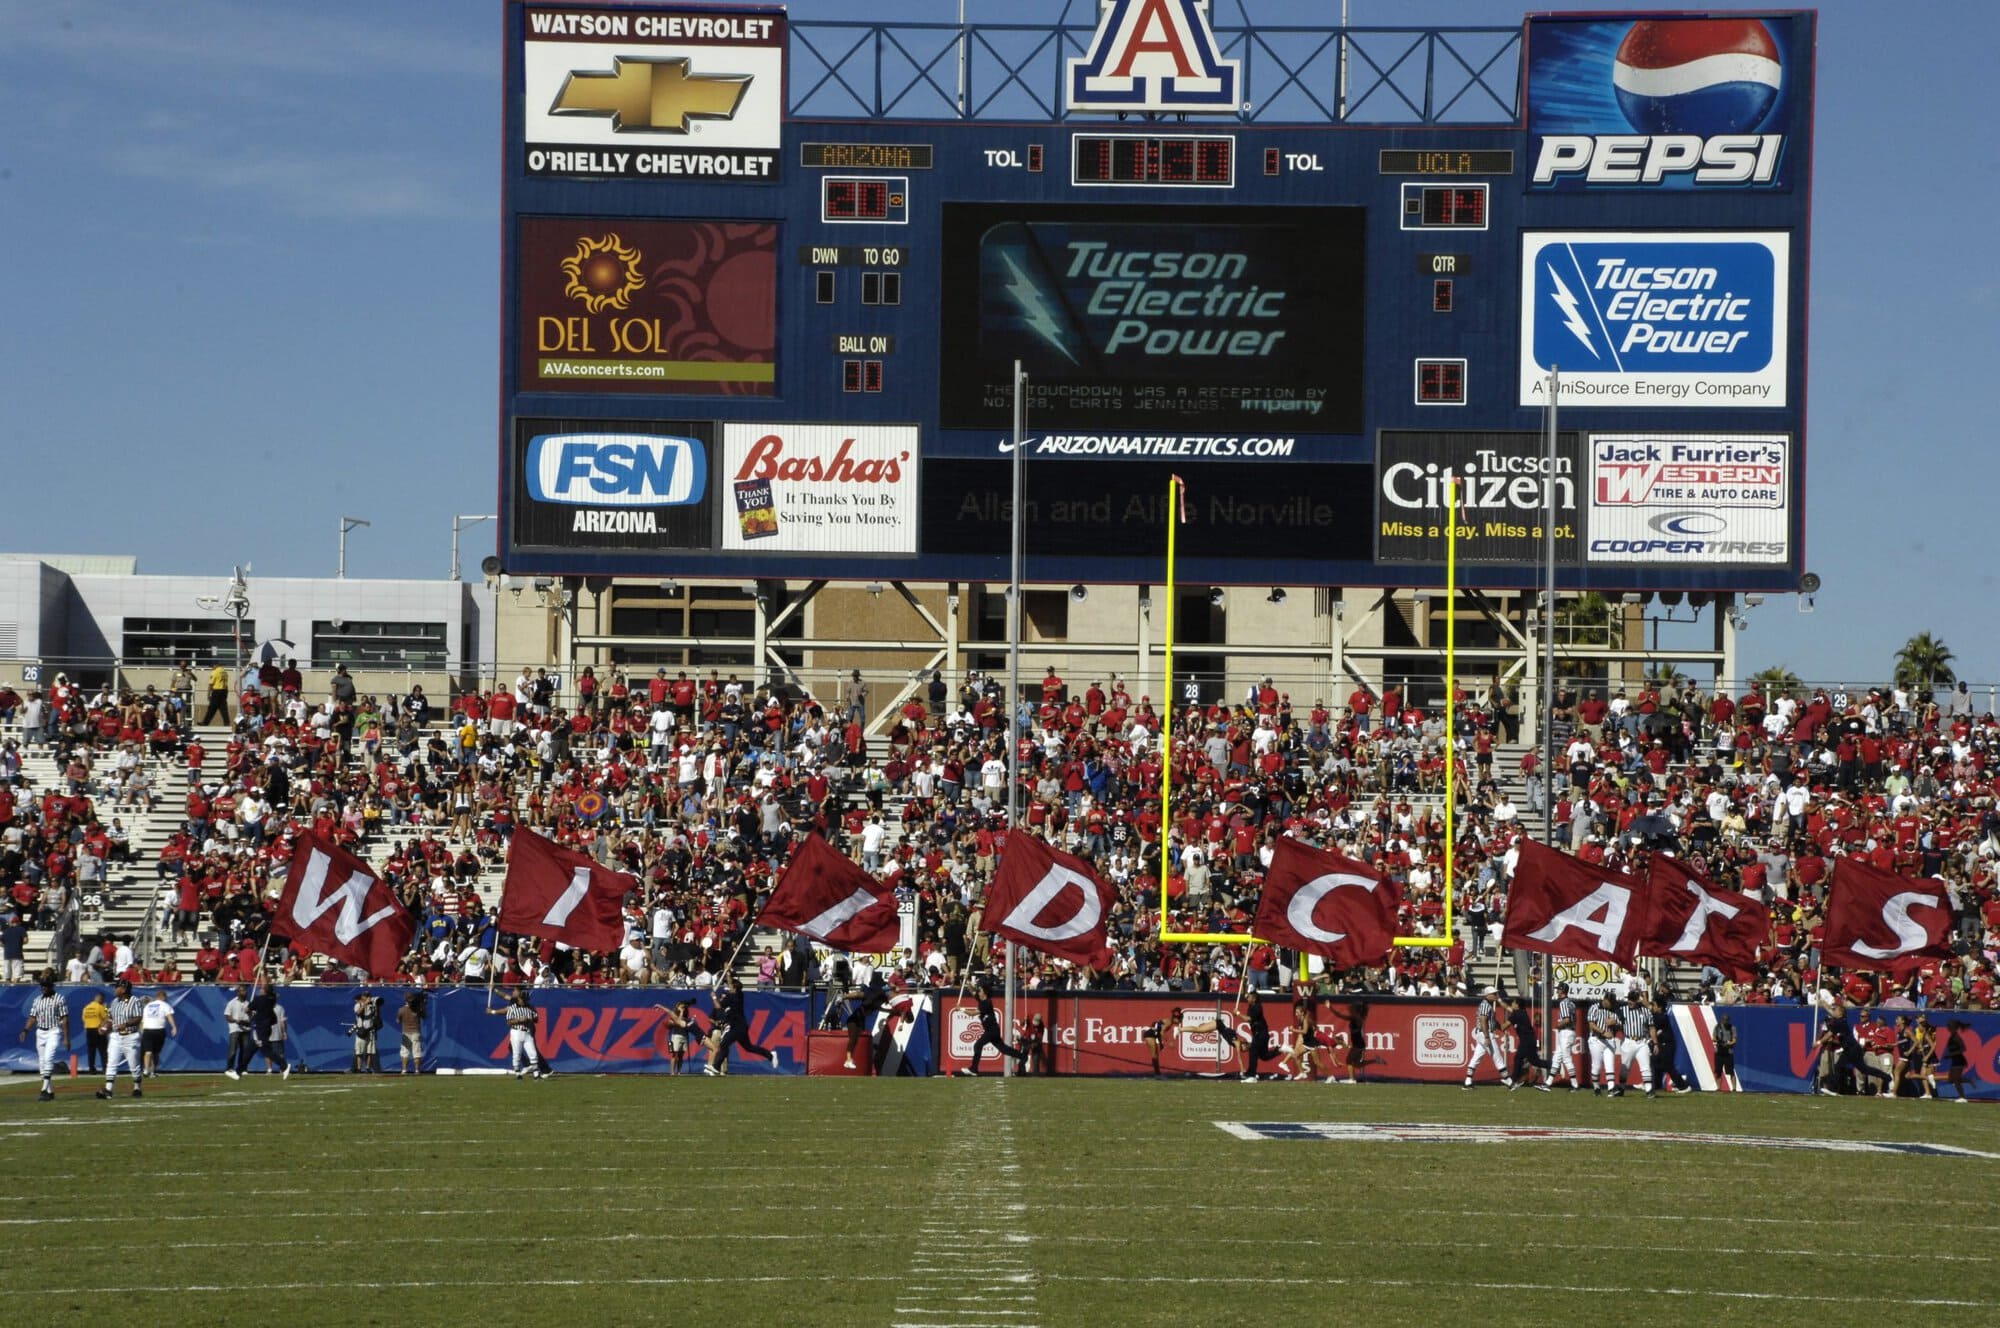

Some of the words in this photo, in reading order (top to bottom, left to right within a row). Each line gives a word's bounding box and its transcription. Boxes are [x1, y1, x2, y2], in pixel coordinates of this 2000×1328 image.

[531, 13, 628, 36] WATSON
[634, 15, 774, 39] CHEVROLET
[528, 149, 631, 173] O'RIELLY
[636, 152, 774, 176] CHEVROLET
[823, 144, 912, 166] ARIZONA
[984, 150, 1023, 168] TOL
[1100, 141, 1229, 180] 11:20
[1285, 154, 1323, 171] TOL
[1417, 153, 1471, 173] UCLA
[1532, 134, 1783, 183] PEPSI
[828, 182, 886, 217] 20
[1443, 190, 1484, 224] 14
[812, 248, 838, 264] DWN
[864, 248, 879, 264] TO
[882, 248, 900, 265] GO
[1066, 242, 1248, 279] Tucson
[1432, 255, 1455, 273] QTR
[1595, 258, 1718, 290] Tucson
[1087, 280, 1286, 317] Electric
[1606, 291, 1751, 321] Electric
[538, 317, 596, 352] DEL
[610, 318, 667, 353] SOL
[839, 336, 866, 353] BALL
[870, 337, 887, 354] ON
[1104, 320, 1286, 355] Power
[1620, 323, 1750, 353] Power
[543, 362, 665, 377] AVAconcerts.com
[1532, 381, 1543, 394] A
[1635, 381, 1690, 398] Energy
[1695, 381, 1771, 399] Company
[1036, 435, 1295, 456] ARIZONAATHLETICS.COM
[1599, 445, 1661, 463] Jack
[1672, 445, 1781, 464] Furrier's
[554, 443, 679, 496] FSN
[734, 434, 910, 483] Bashas'
[1476, 450, 1573, 474] Tucson
[737, 487, 770, 500] THANK
[1382, 462, 1576, 510] Citizen
[1600, 464, 1781, 503] WESTERN
[1653, 488, 1684, 500] TIRE
[1687, 488, 1696, 500] &
[1701, 489, 1738, 501] AUTO
[1741, 489, 1778, 501] CARE
[743, 496, 768, 509] YOU
[786, 492, 797, 505] It
[801, 492, 849, 506] Thanks
[853, 494, 876, 506] You
[880, 494, 897, 510] By
[1049, 492, 1111, 523] and
[1208, 495, 1335, 527] Norville
[572, 510, 657, 534] ARIZONA
[780, 511, 823, 527] Saving
[827, 512, 851, 525] You
[855, 513, 901, 528] Money.
[1382, 522, 1423, 537] Miss
[1428, 526, 1439, 538] a
[1485, 522, 1527, 538] Miss
[1532, 527, 1543, 539] a
[24, 666, 38, 681] 26
[1185, 683, 1199, 698] 28
[1834, 693, 1848, 708] 29
[83, 894, 102, 907] 26
[292, 847, 396, 946] W
[897, 902, 914, 912] 28
[1002, 862, 1102, 941] D
[1287, 872, 1379, 944] C
[1526, 881, 1632, 954] A
[1669, 879, 1740, 952] T
[1851, 890, 1939, 960] S
